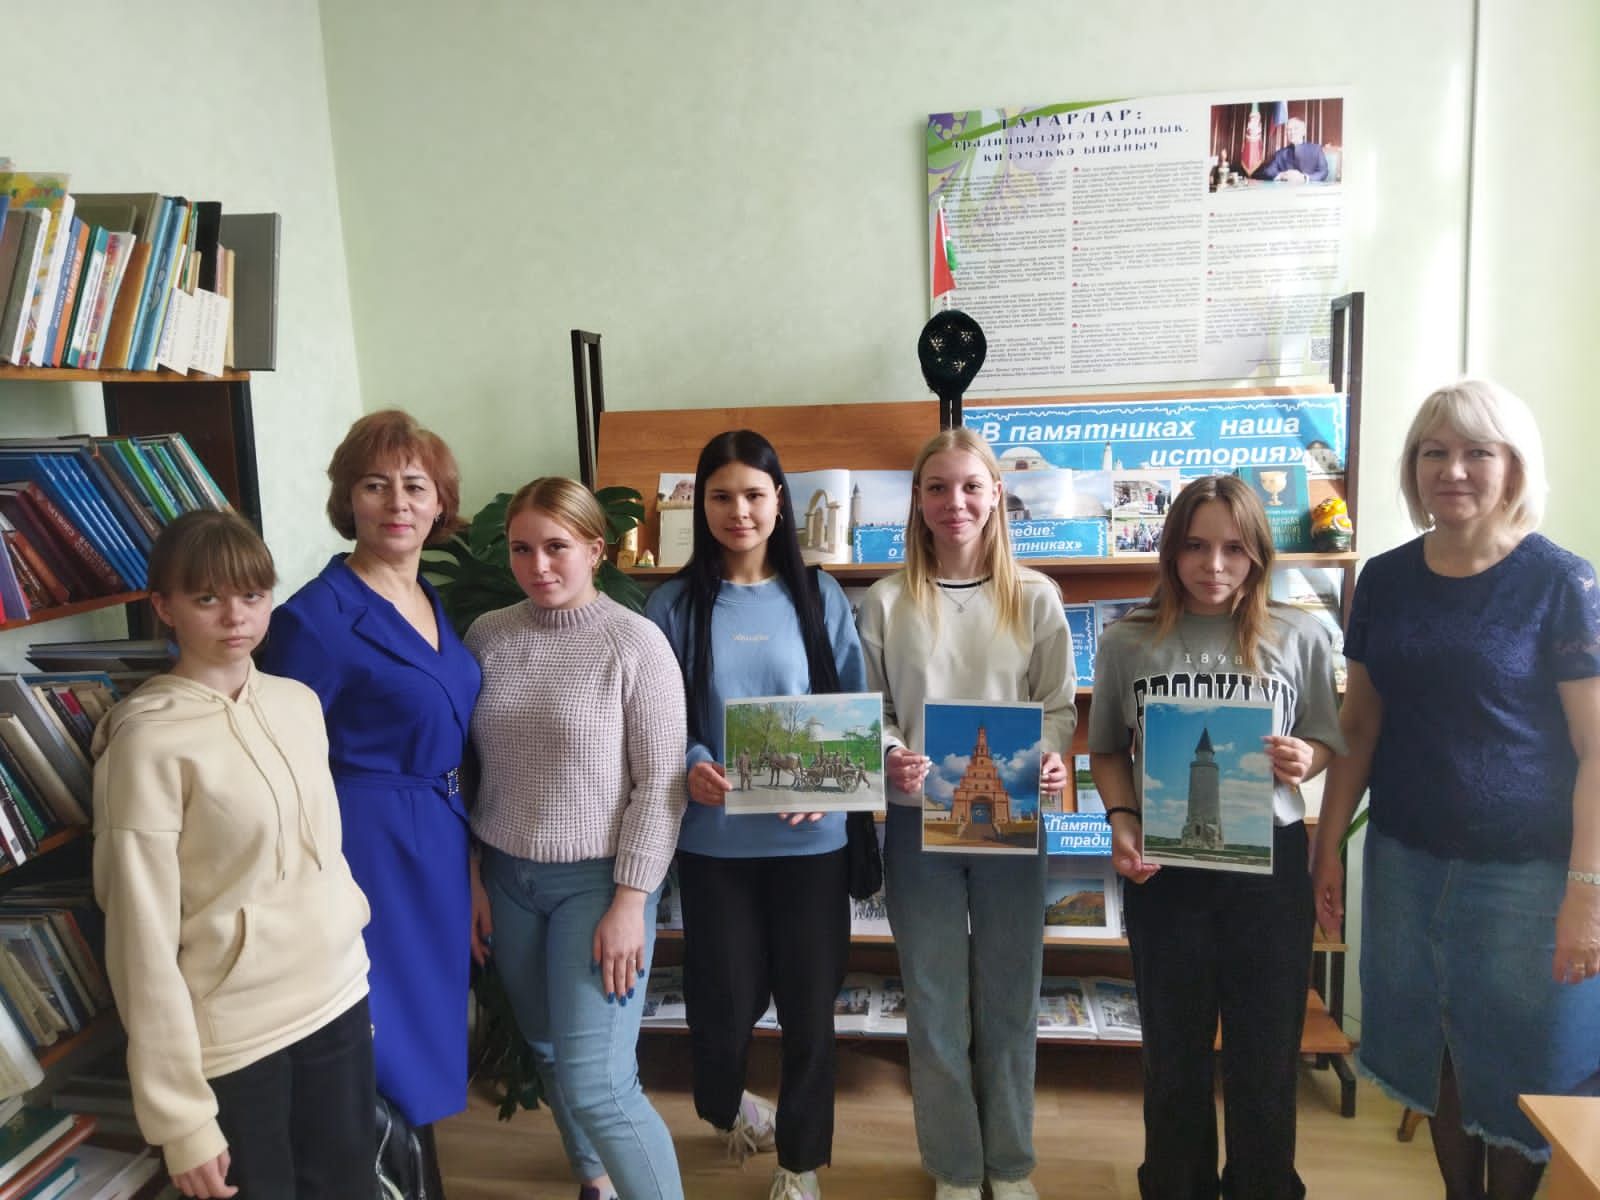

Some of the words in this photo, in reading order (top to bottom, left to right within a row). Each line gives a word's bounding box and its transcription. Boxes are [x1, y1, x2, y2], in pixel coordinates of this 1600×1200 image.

[1000, 108, 1142, 130] ТАТАРЛАР:
[1009, 420, 1196, 442] памятниках
[1219, 416, 1300, 436] наша
[1150, 446, 1304, 468] история»
[1060, 832, 1111, 848] тради
